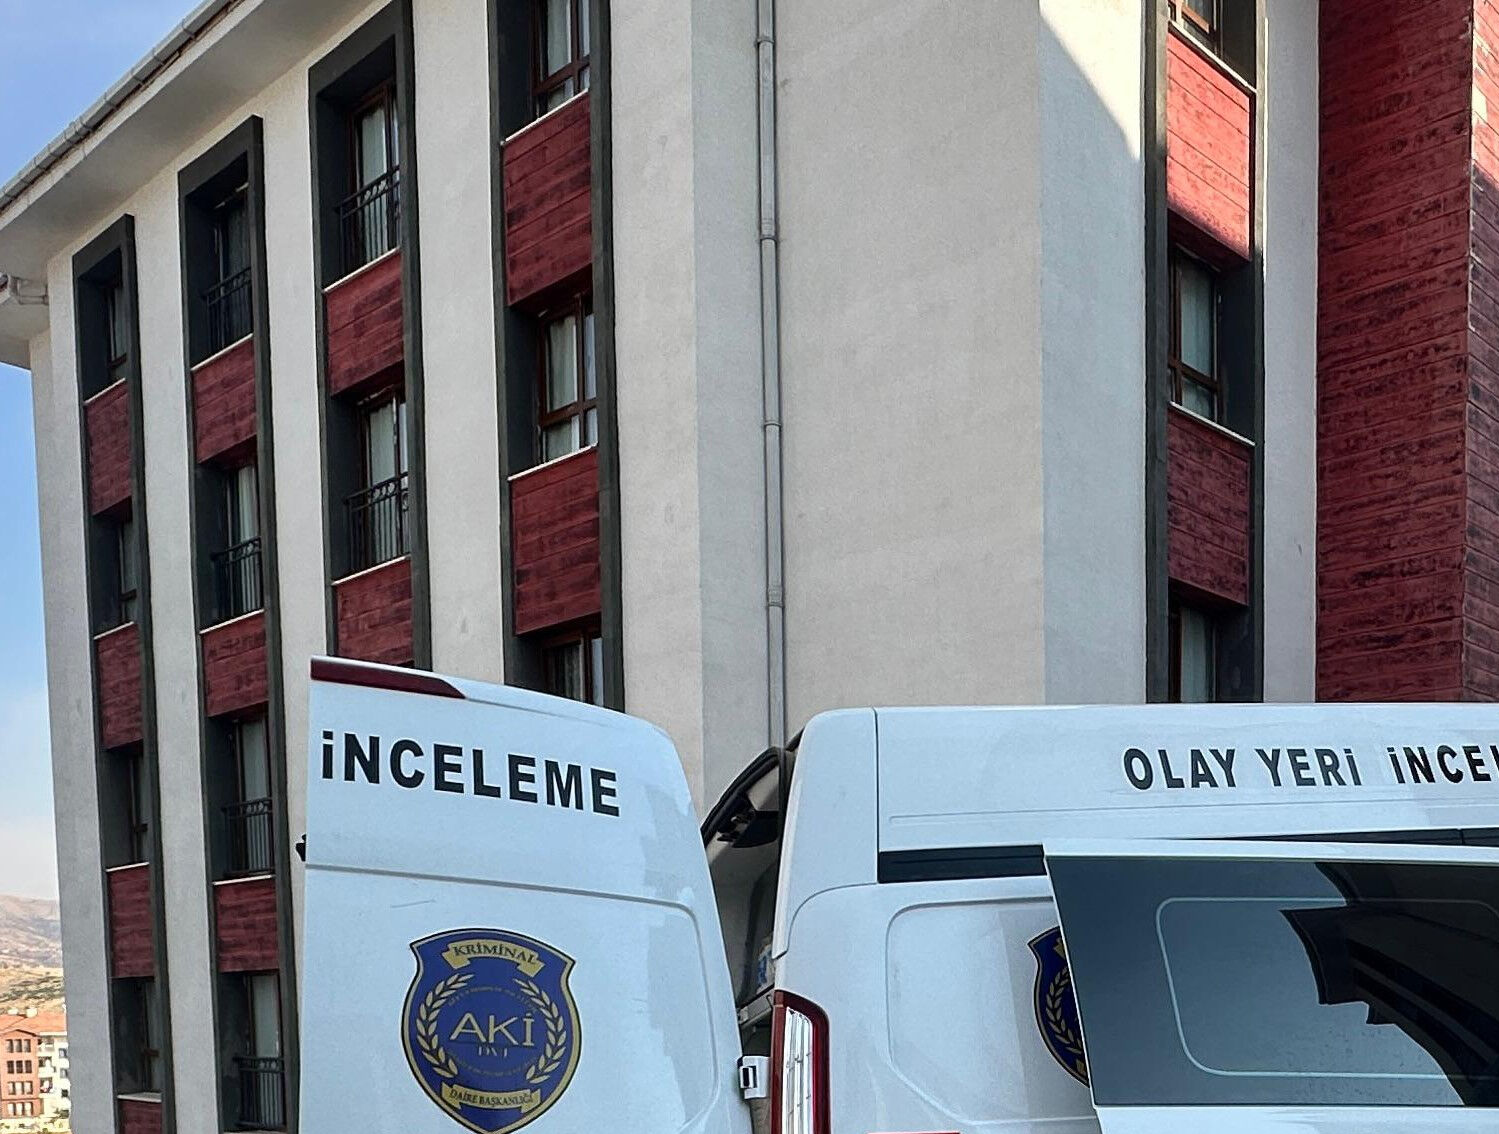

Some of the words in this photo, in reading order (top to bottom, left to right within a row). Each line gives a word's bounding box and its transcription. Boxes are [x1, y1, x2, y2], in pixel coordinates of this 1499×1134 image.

[1123, 747, 1238, 790] OLAY
[453, 942, 539, 964] KRİMİNAL
[450, 1011, 536, 1047] AKİ
